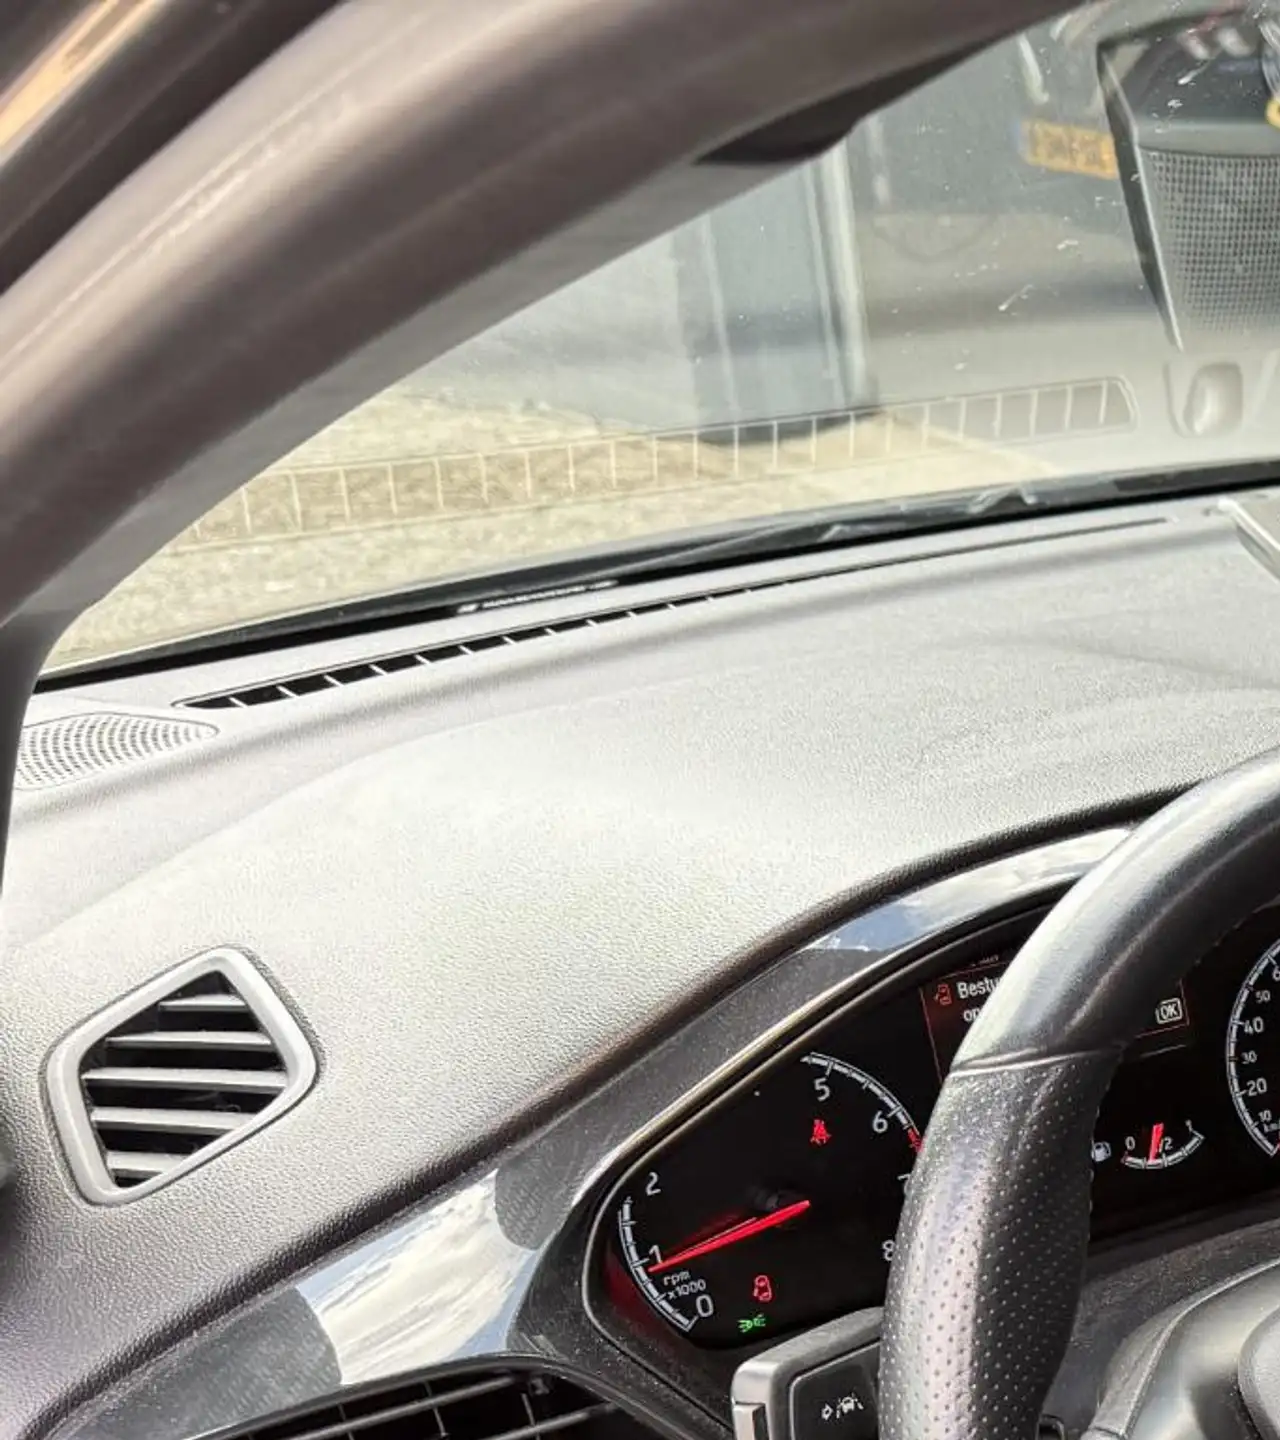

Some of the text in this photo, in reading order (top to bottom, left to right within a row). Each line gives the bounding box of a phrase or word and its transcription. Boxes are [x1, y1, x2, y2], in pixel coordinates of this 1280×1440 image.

[1256, 989, 1271, 1003] 50
[1160, 1003, 1178, 1020] OK
[1244, 1017, 1264, 1034] 40
[1241, 1051, 1257, 1065] 30
[814, 1078, 831, 1101] 5
[1247, 1078, 1267, 1096] 20
[872, 1110, 889, 1133] 6
[1258, 1110, 1272, 1123] 10
[1124, 1136, 1136, 1151] 0
[645, 1172, 662, 1196] 2
[649, 1245, 663, 1264] 1
[882, 1240, 896, 1262] 8
[663, 1271, 691, 1287] rpm
[667, 1279, 707, 1300] x1000
[695, 1294, 714, 1317] 0
